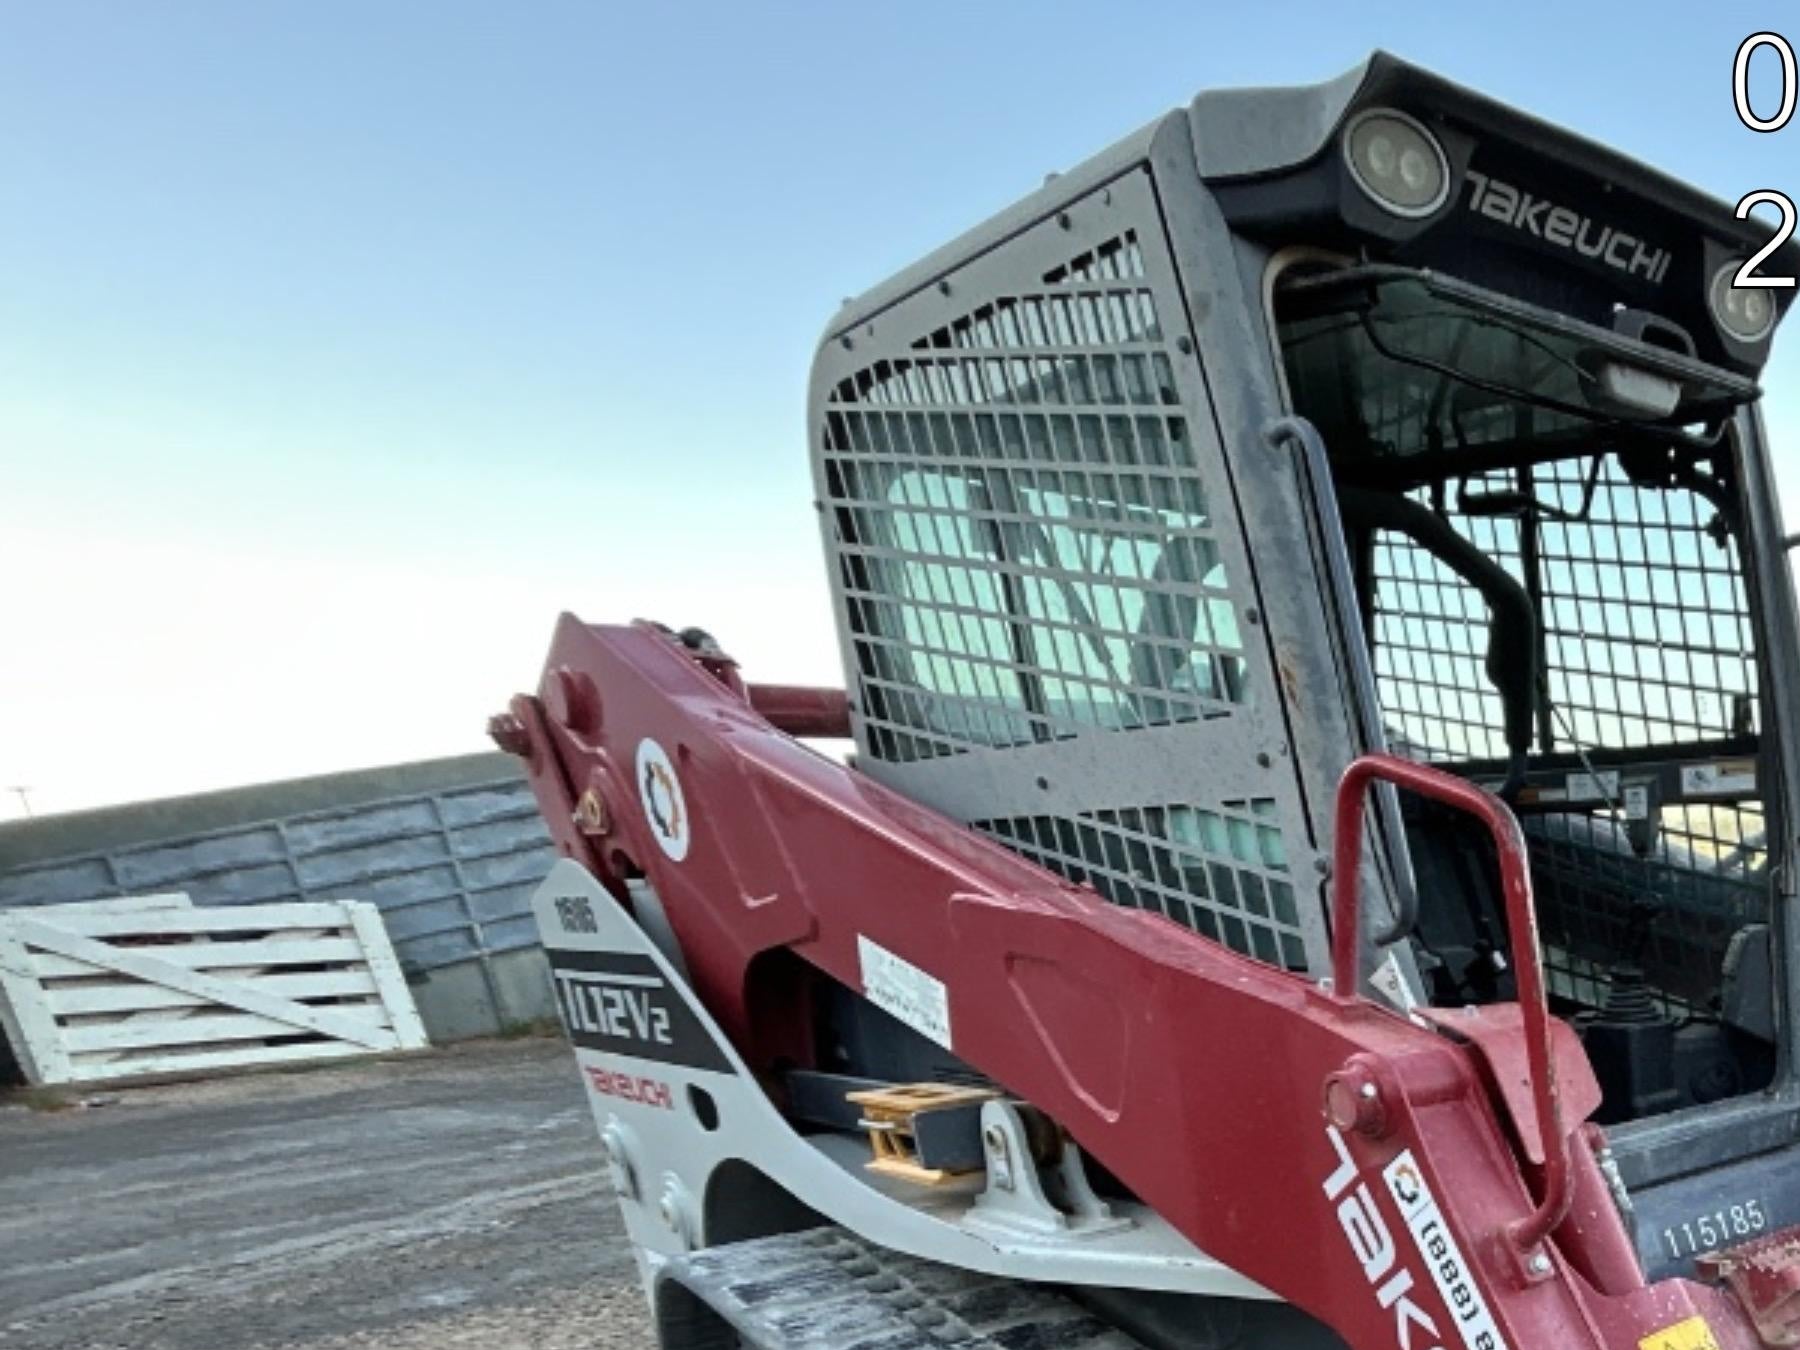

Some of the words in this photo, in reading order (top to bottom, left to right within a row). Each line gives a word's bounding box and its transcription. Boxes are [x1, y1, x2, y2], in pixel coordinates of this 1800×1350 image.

[1464, 170, 1672, 285] TAKEUCHI
[554, 968, 673, 1044] TL12V2
[1418, 1222, 1481, 1323] (888)
[1664, 1199, 1766, 1258] 115185
